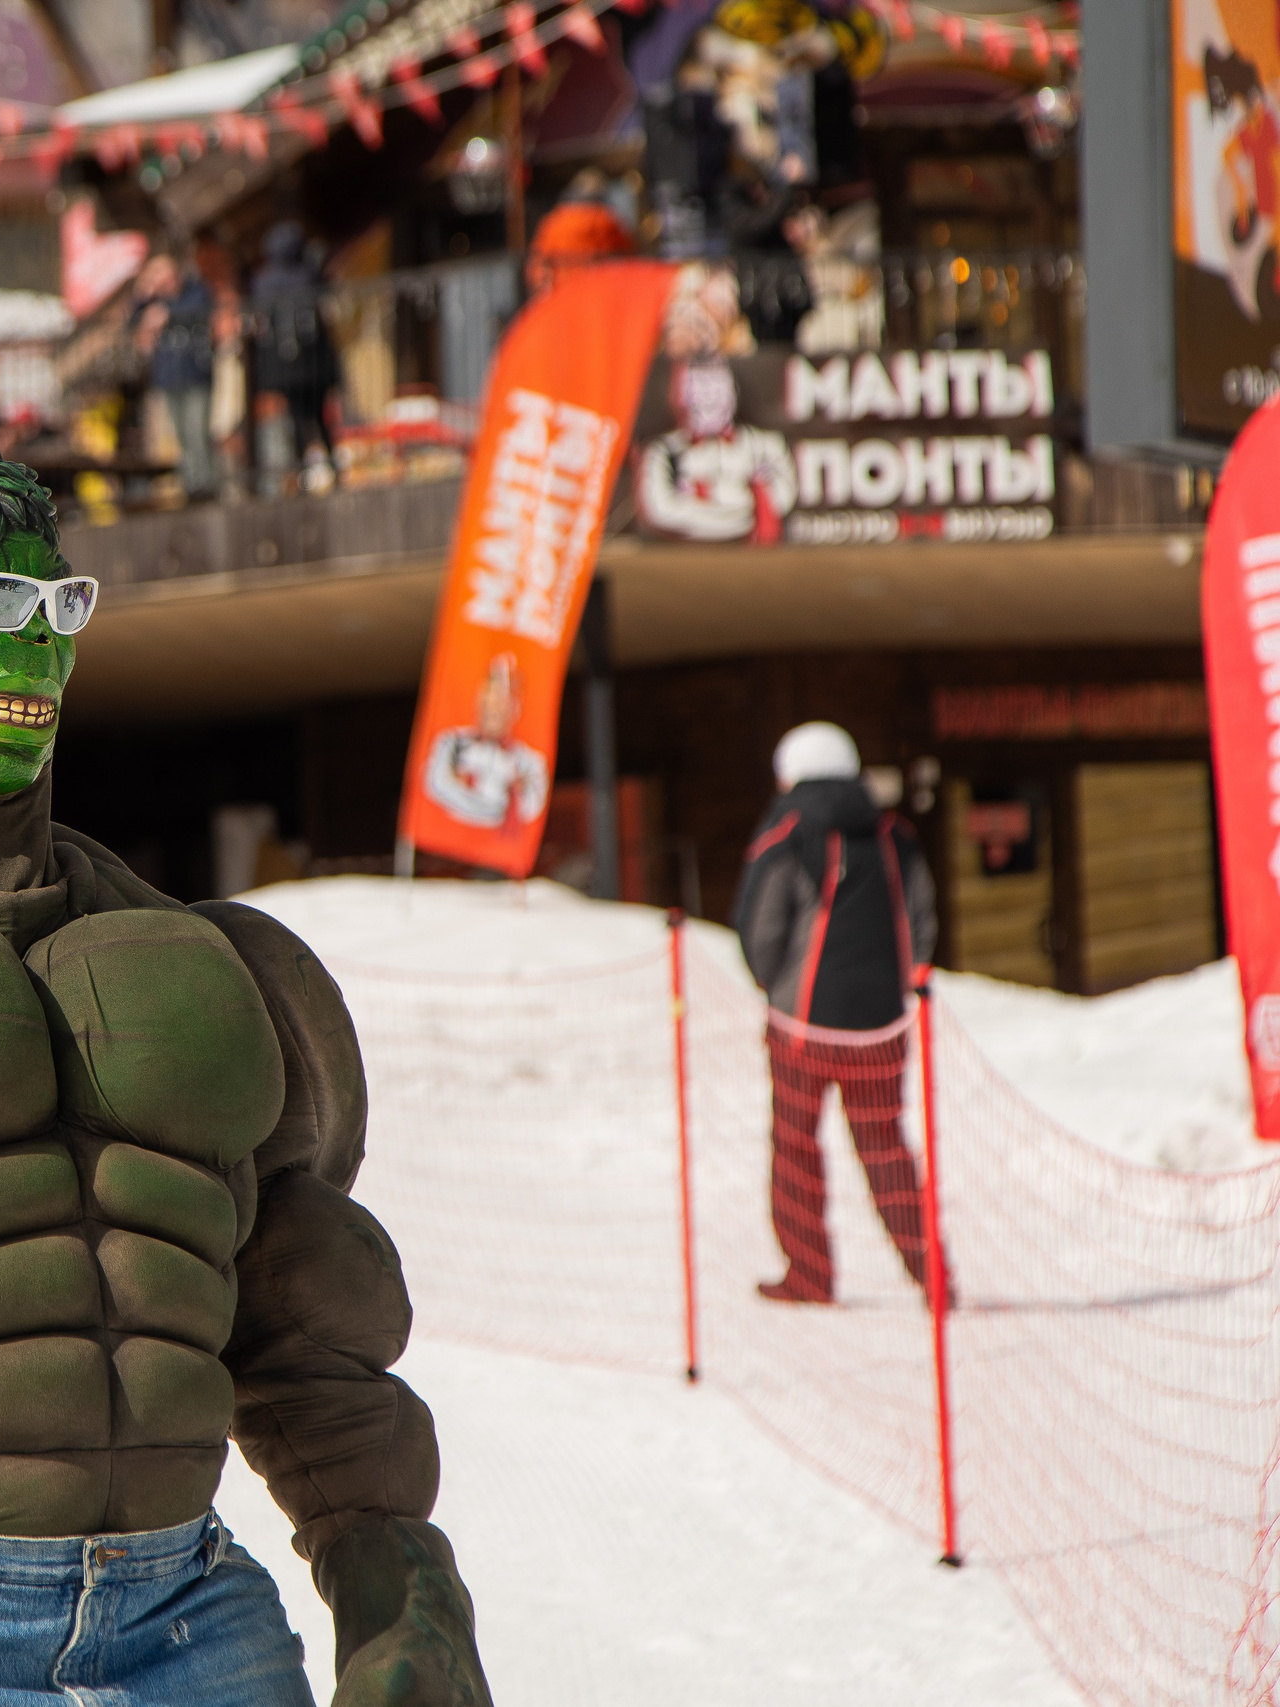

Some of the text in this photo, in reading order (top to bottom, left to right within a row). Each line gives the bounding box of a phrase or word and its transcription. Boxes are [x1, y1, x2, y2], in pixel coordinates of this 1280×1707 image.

[785, 350, 1054, 423] МАНТЫ
[463, 386, 555, 631] МАНТЫ
[513, 400, 602, 645] ПОНТЫ
[796, 434, 1055, 507] ПОНТЫ
